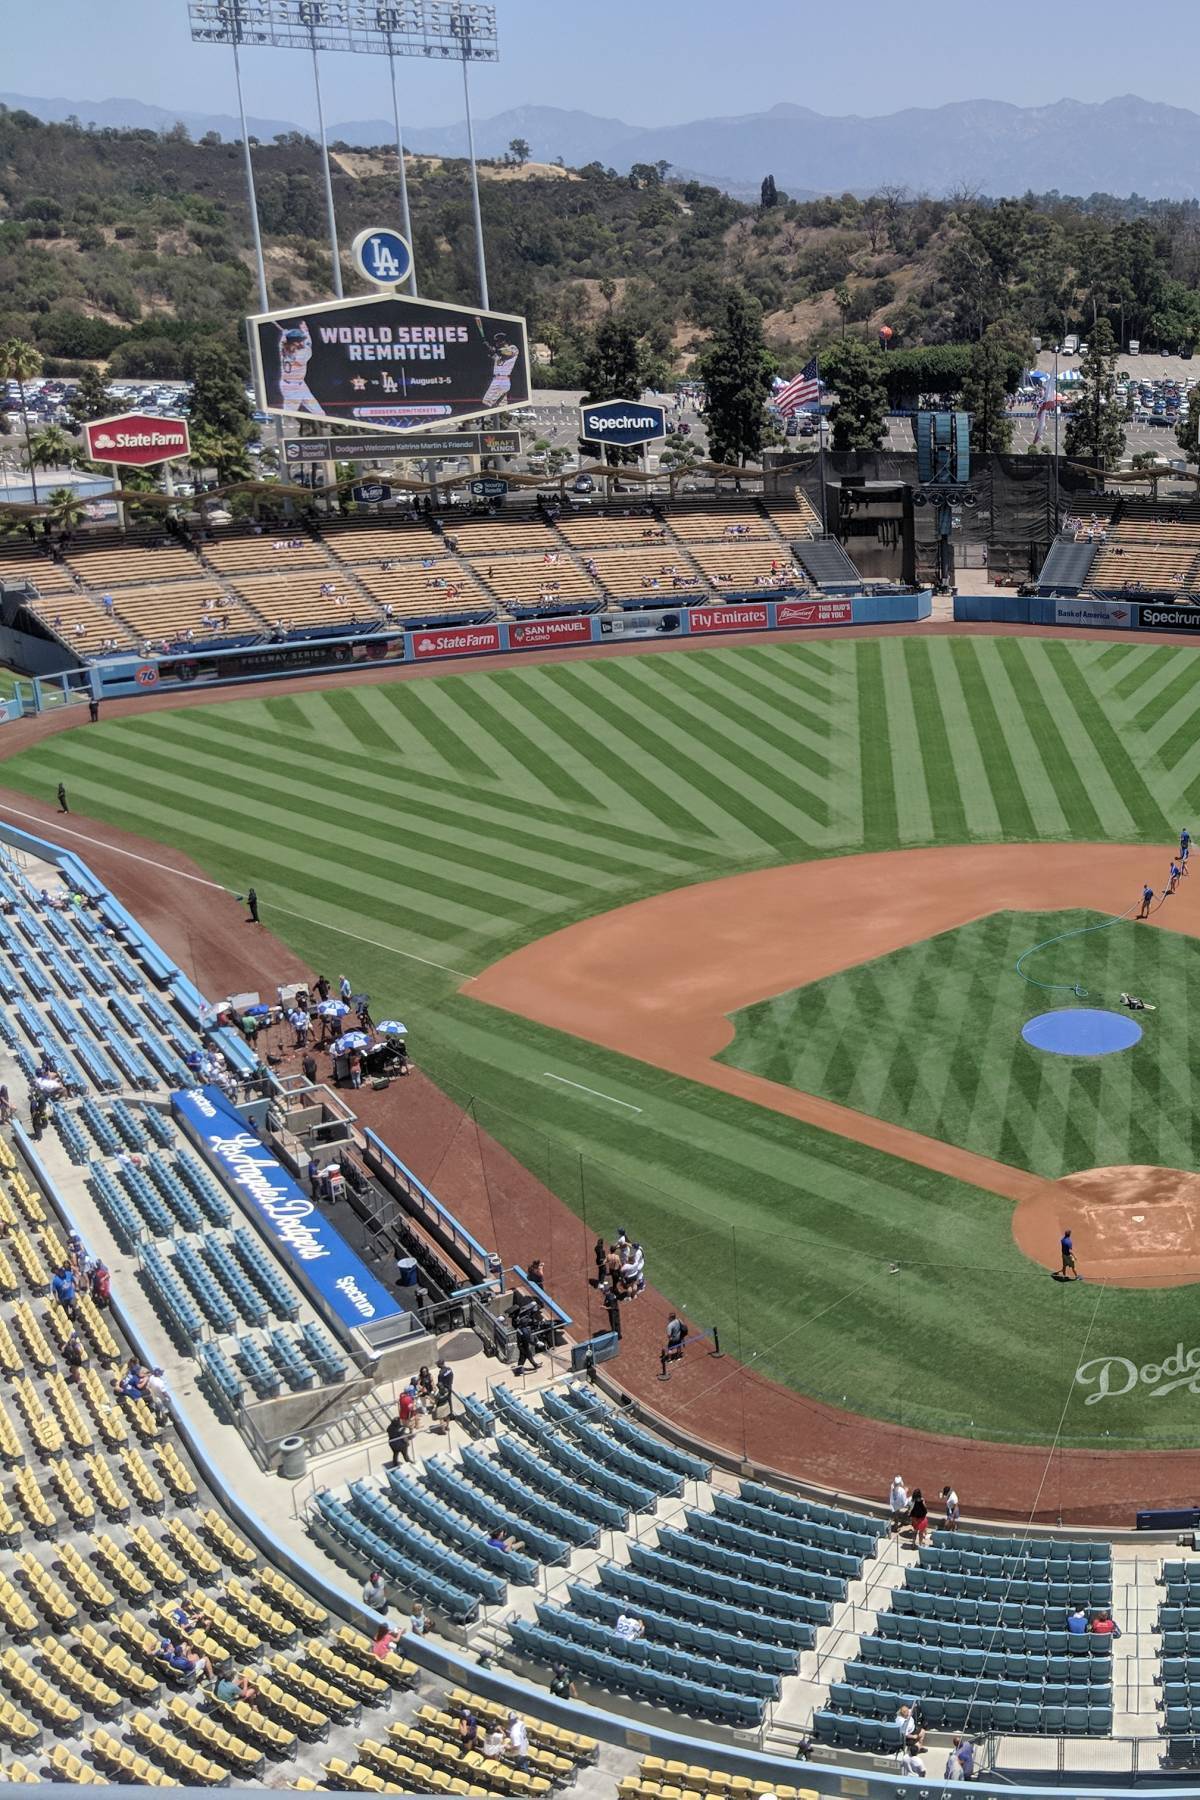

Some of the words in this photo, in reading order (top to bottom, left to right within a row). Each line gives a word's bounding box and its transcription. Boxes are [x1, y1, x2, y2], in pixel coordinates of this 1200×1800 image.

[371, 239, 399, 276] LA
[320, 327, 393, 344] WORLD
[399, 326, 469, 343] SERIES
[349, 343, 446, 361] REMATCH
[410, 376, 437, 387] August
[589, 416, 654, 432] Spectrum
[691, 612, 712, 628] Fly
[714, 610, 766, 624] Emirates
[1058, 609, 1074, 617] Bank
[1075, 610, 1082, 618] of
[1082, 610, 1110, 619] America
[524, 625, 545, 636] SAN
[546, 622, 586, 634] MANUEL
[140, 670, 156, 682] 76
[226, 1151, 290, 1210] Angeles
[262, 1199, 331, 1260] Dodgers
[336, 1275, 376, 1318] Spectrum
